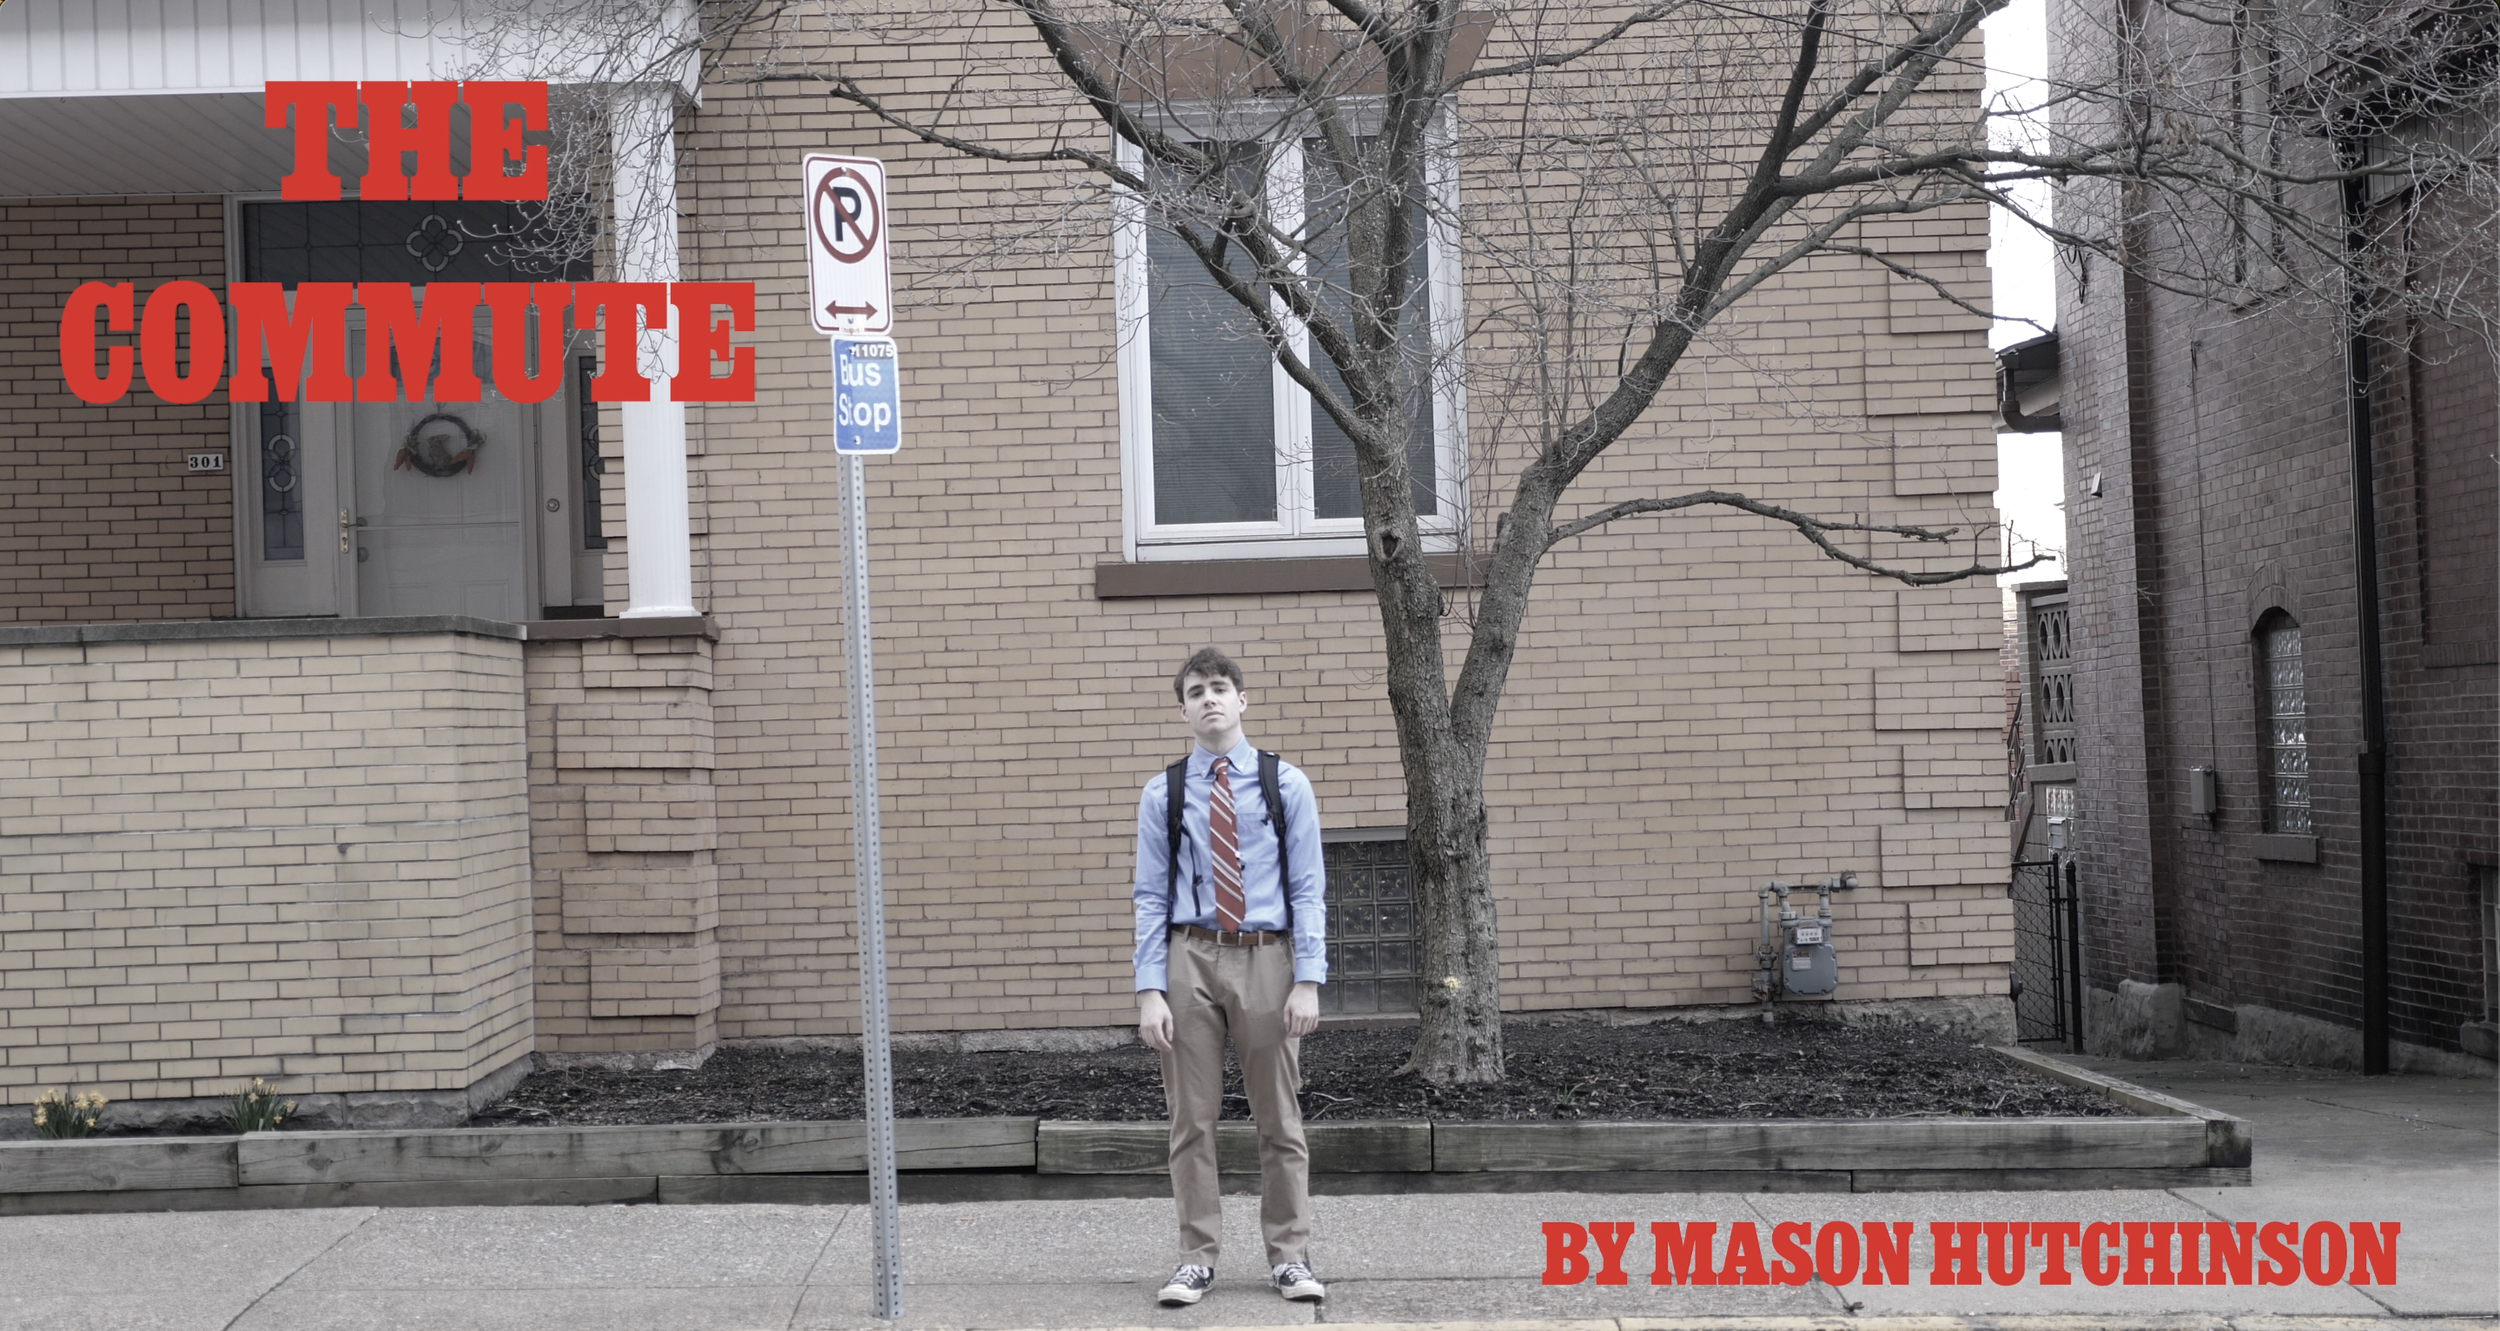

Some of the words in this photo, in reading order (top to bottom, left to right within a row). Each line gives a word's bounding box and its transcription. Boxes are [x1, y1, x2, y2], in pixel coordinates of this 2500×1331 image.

[832, 186, 862, 242] P
[840, 354, 882, 387] Bus
[839, 393, 891, 433] Stop
[190, 456, 221, 468] 301
